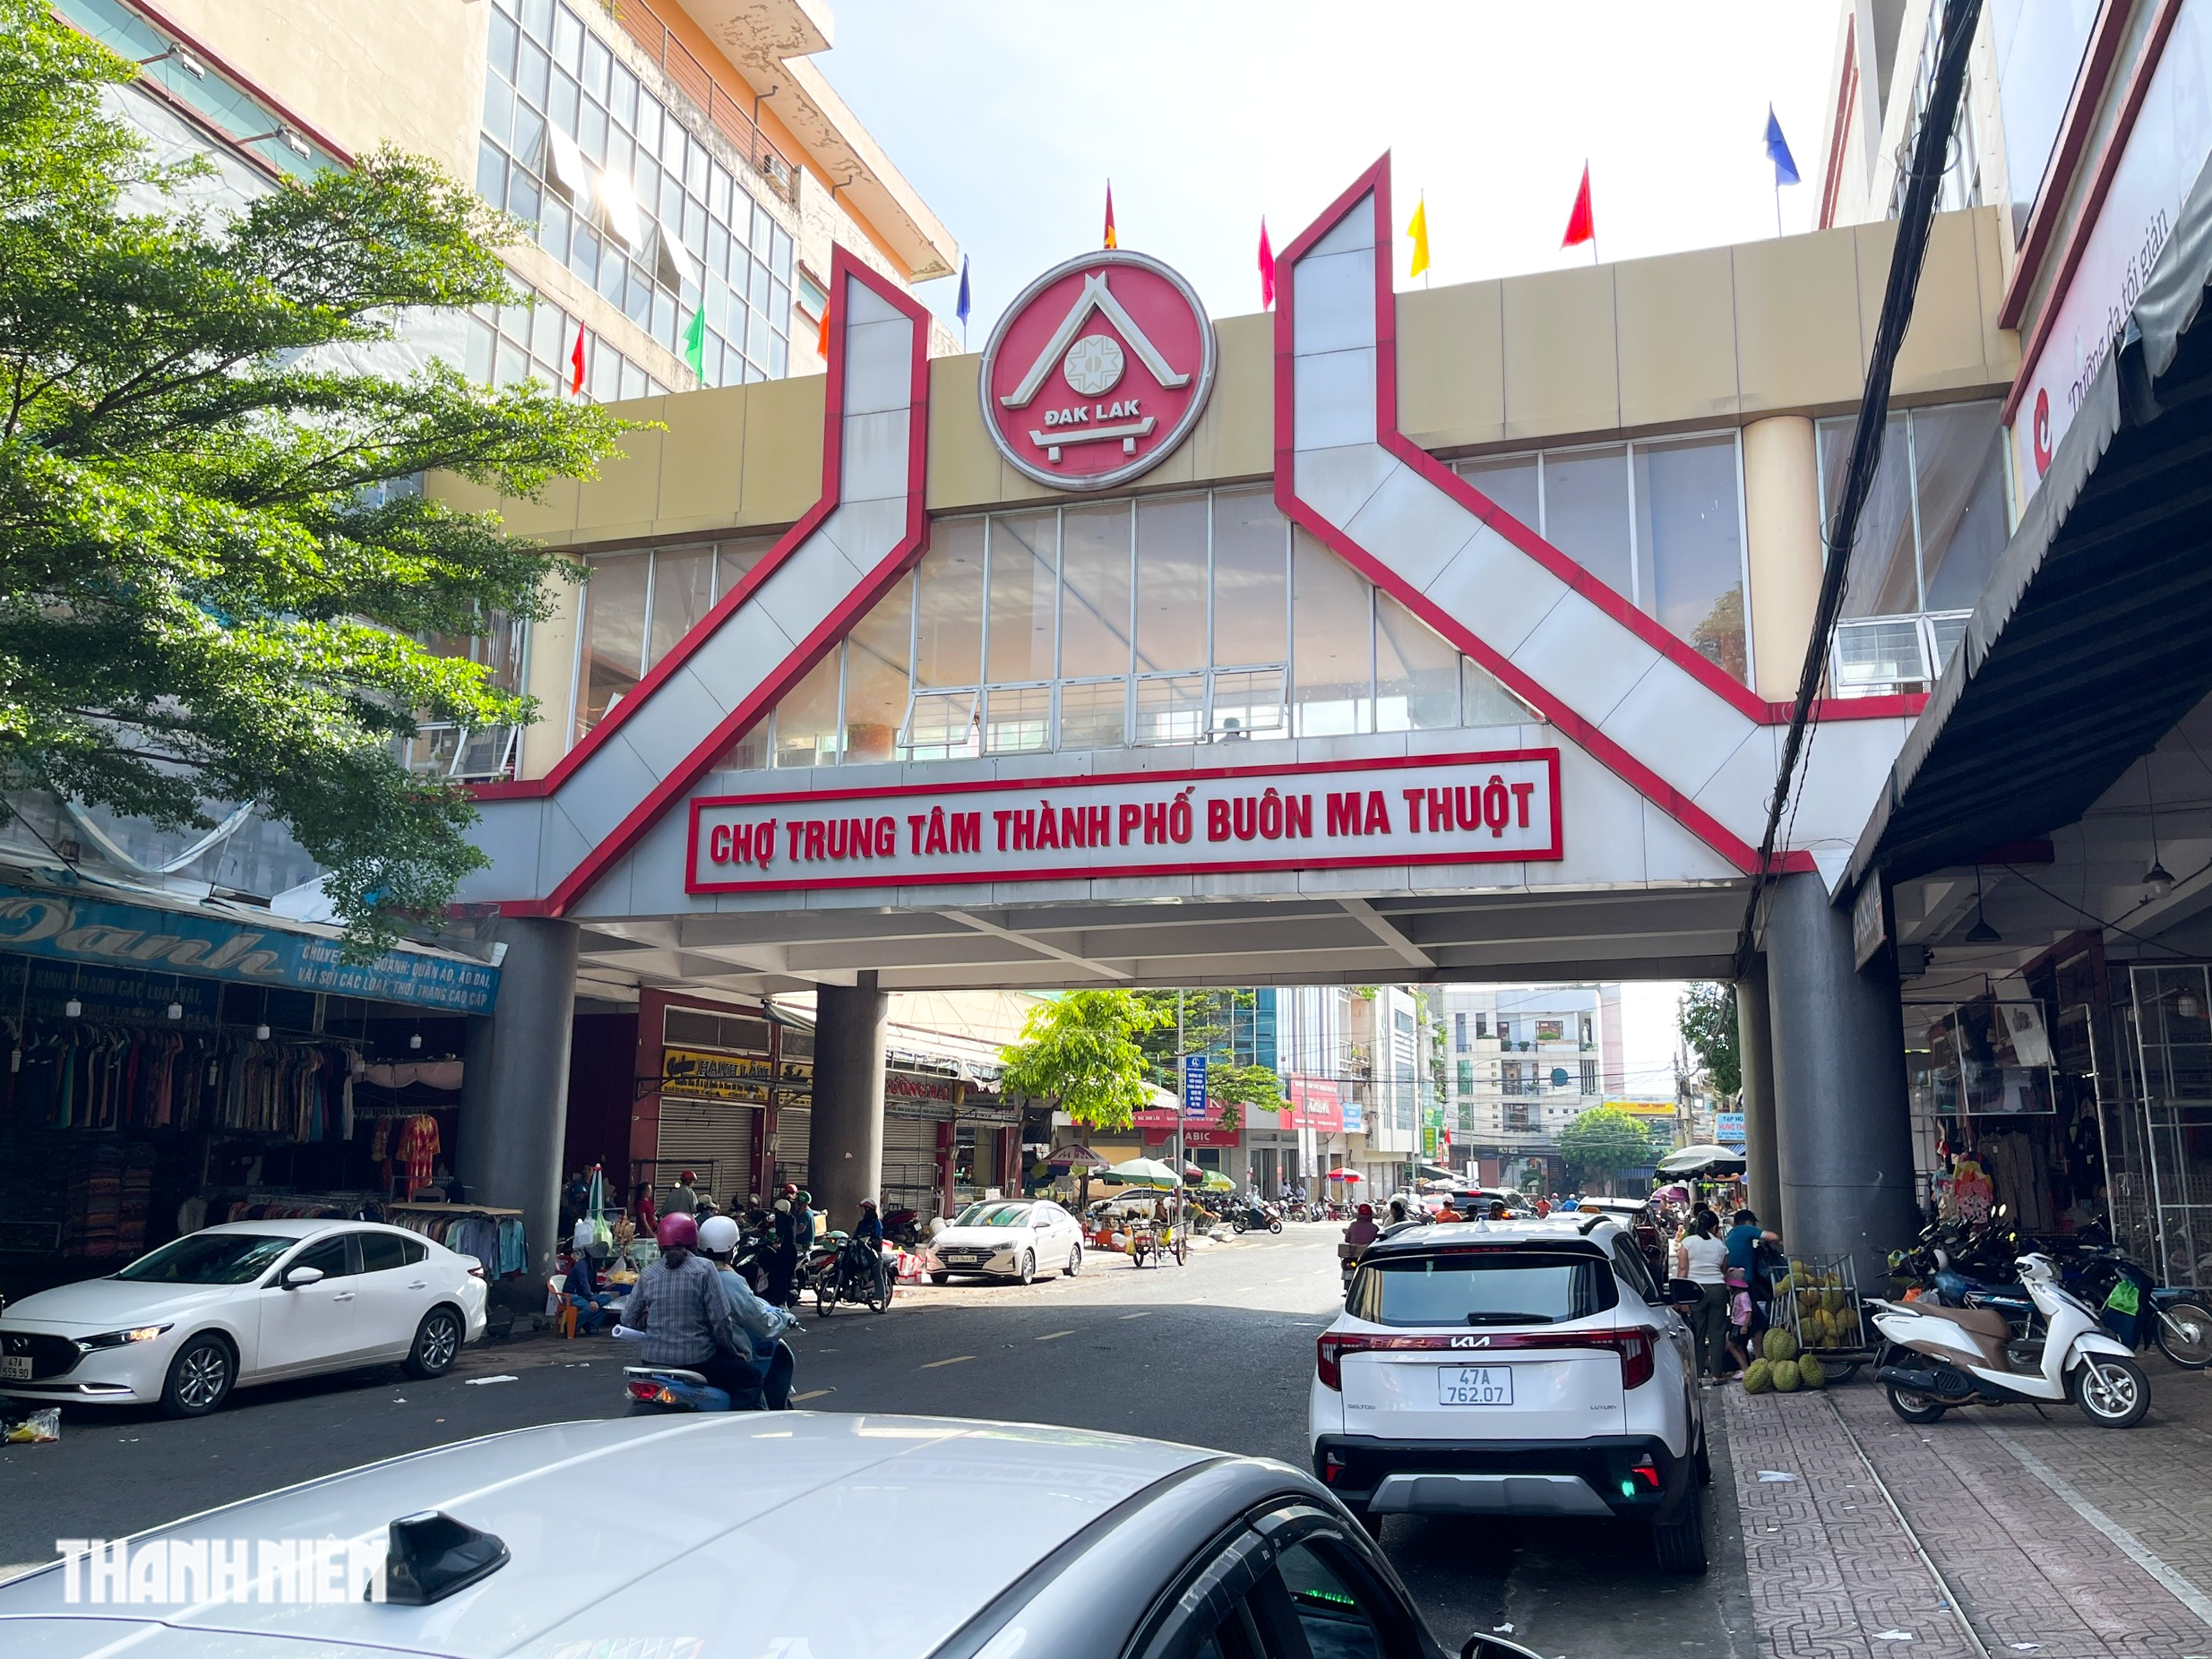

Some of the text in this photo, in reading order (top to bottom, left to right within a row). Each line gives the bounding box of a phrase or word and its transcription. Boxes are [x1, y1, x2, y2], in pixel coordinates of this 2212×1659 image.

[2122, 255, 2139, 314] tối
[2140, 208, 2168, 286] giản
[1045, 400, 1140, 427] ĐAK LAK
[710, 774, 1535, 870] CHỢ TRUNG TÂM THÀNH PHỐ BUÔN MA THUỘT
[1184, 1131, 1210, 1141] ABIC
[1450, 1336, 1491, 1348] KIA
[1459, 1369, 1491, 1385] 47A
[1448, 1387, 1503, 1402] 762.07
